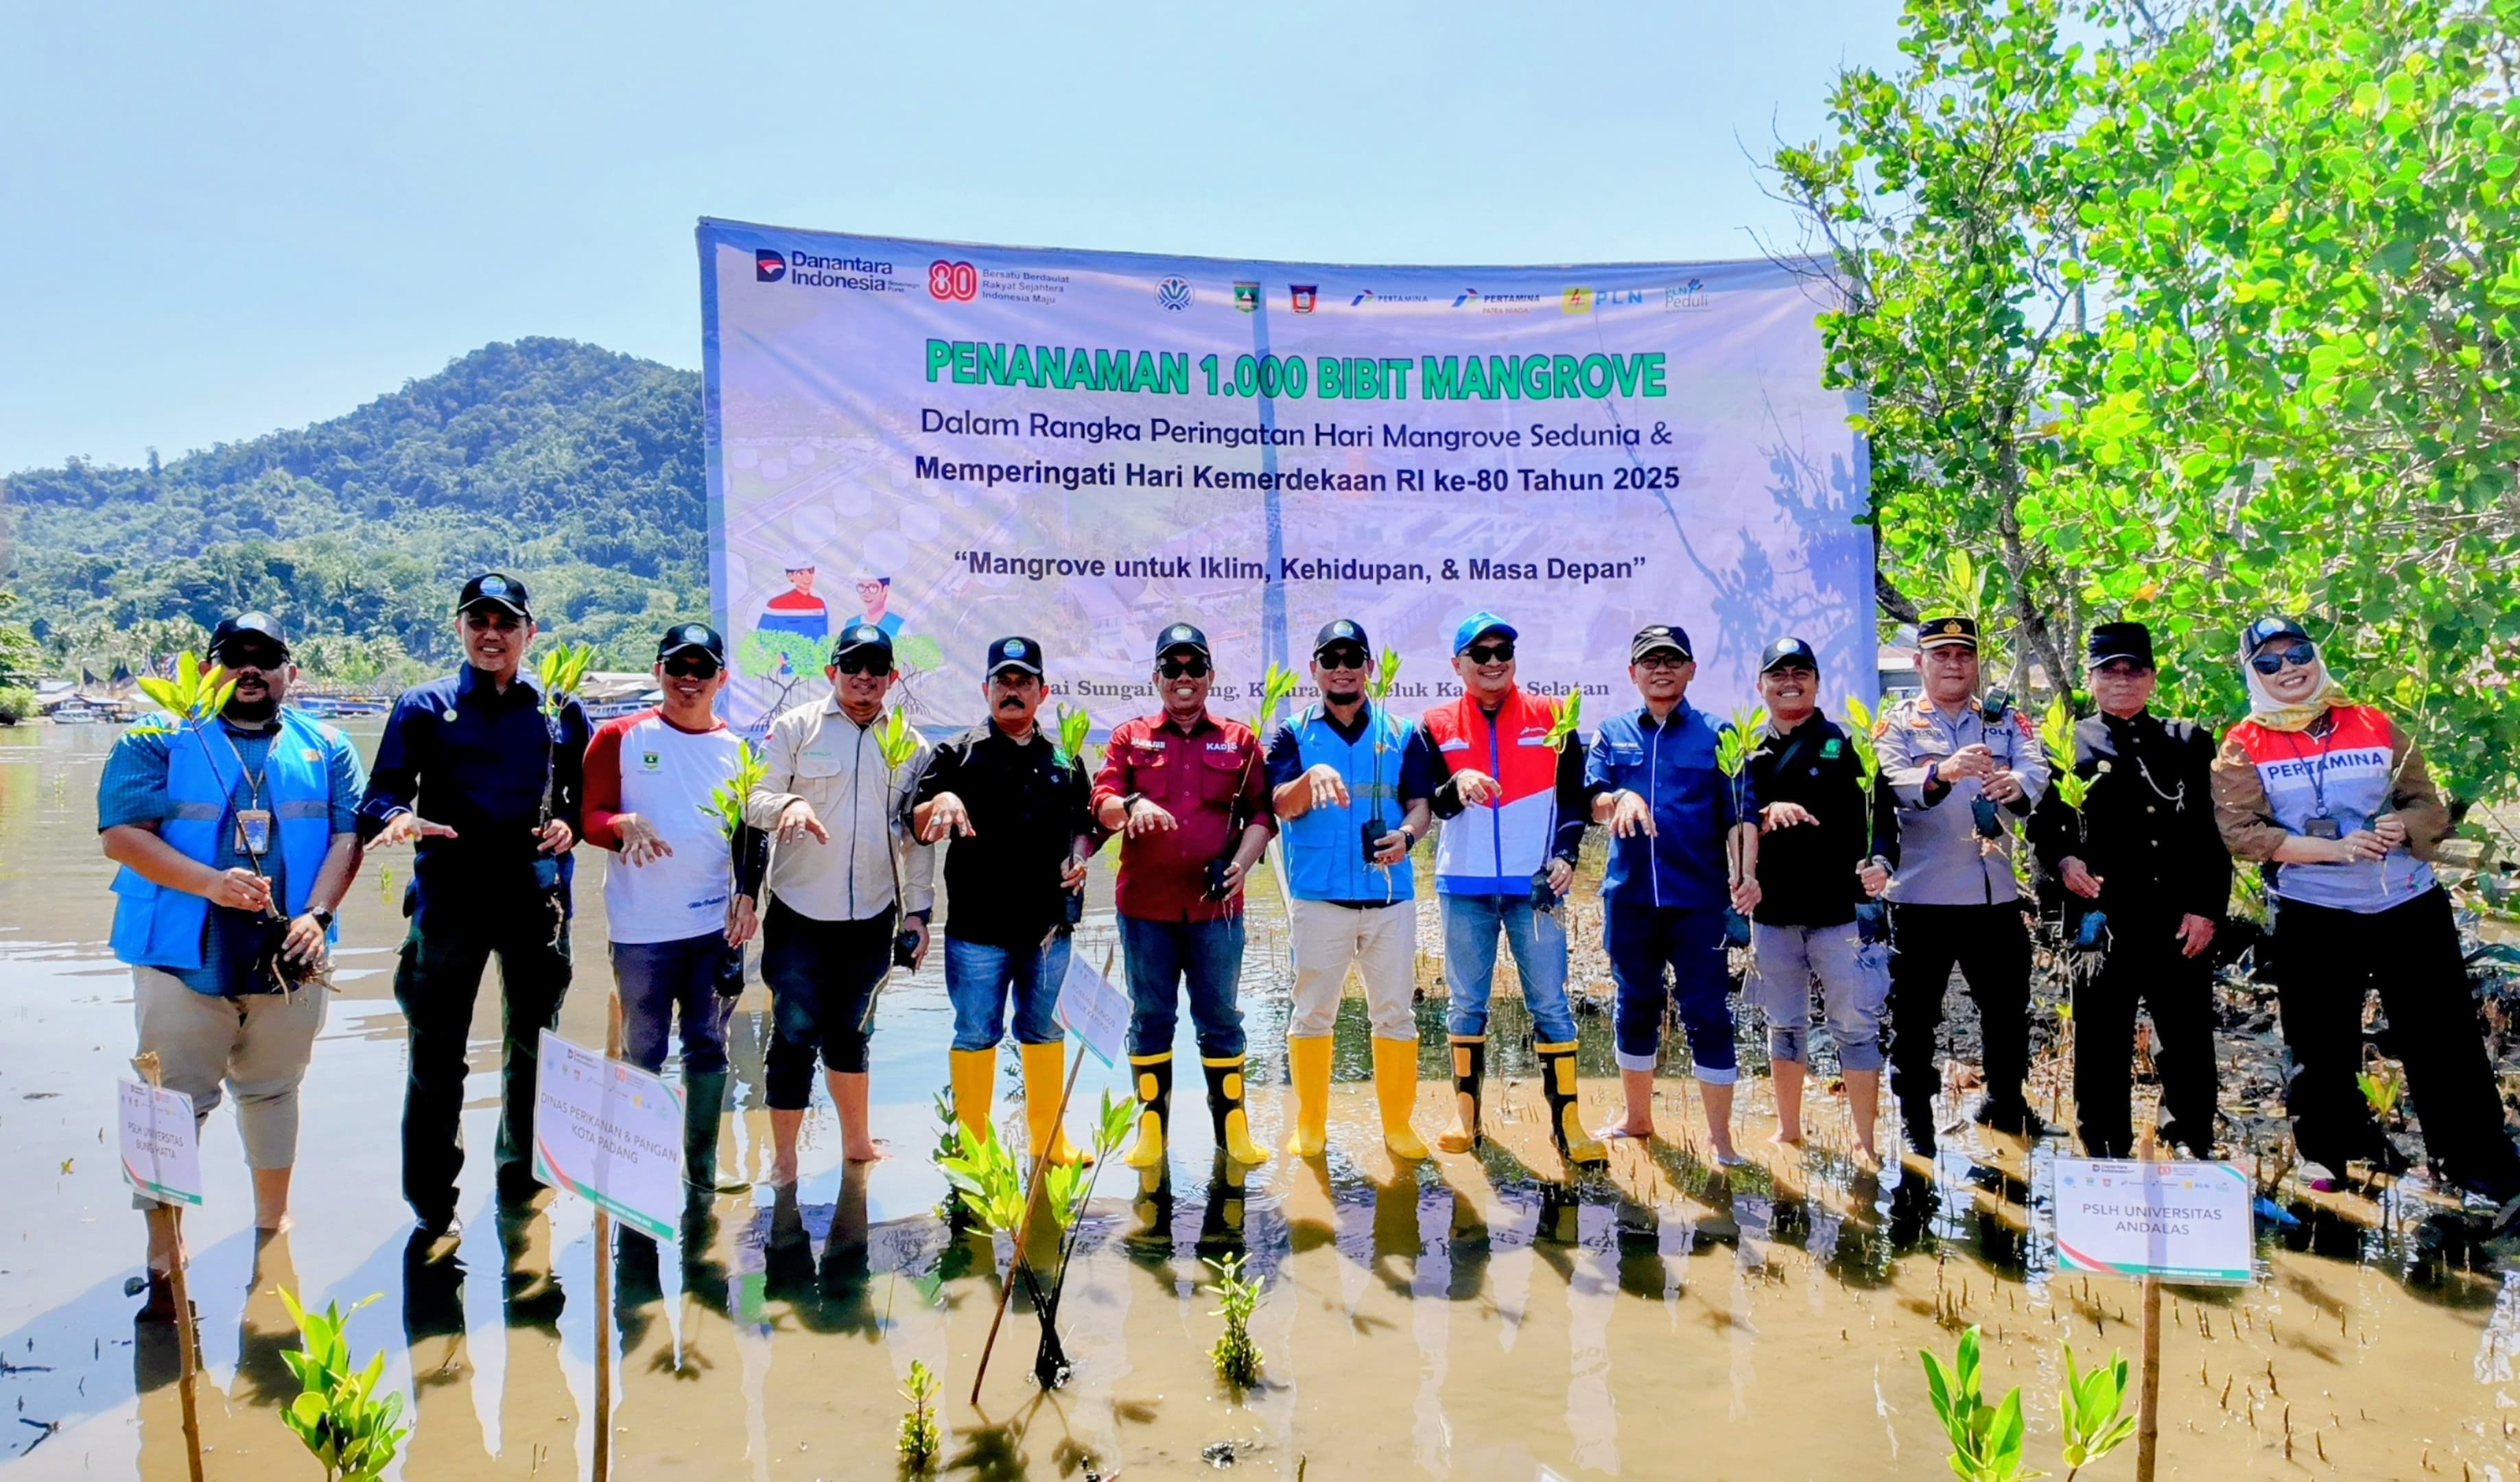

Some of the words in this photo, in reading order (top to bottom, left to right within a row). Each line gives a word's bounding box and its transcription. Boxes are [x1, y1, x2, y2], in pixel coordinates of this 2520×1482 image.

[791, 250, 893, 274] Danantara
[791, 268, 885, 291] Indonesia
[929, 259, 978, 302] 80
[982, 268, 1021, 279] Bersatu
[1023, 272, 1070, 283] Berdaulat
[982, 280, 1016, 292] Rakyat
[1019, 281, 1064, 293] Sejahtera
[982, 290, 1030, 302] Indonesia
[1032, 294, 1056, 305] Maju
[1378, 295, 1428, 303] PERTAMINA
[1483, 294, 1540, 303] PERTAMINA
[1595, 290, 1643, 305] PLN
[1665, 294, 1708, 308] Peduli
[926, 338, 1188, 394] PENANAMAN
[1199, 353, 1306, 399] 1.000
[1317, 356, 1413, 399] BIBIT
[1422, 352, 1667, 400] MANGROVE
[921, 409, 1020, 437] Dalam
[1030, 413, 1141, 445] Rangka
[1151, 419, 1305, 450] Peringatan
[1315, 423, 1374, 447] Hari
[1383, 423, 1520, 451] Mangrove
[1531, 421, 1640, 447] Sedunia
[1650, 421, 1673, 445] &
[915, 456, 1116, 489] Memperingati
[1126, 462, 1182, 488] Hari
[1193, 465, 1387, 492] Kemerdekaan
[1396, 468, 1424, 491] RI
[1435, 468, 1509, 492] ke-80
[1518, 467, 1605, 491] Tahun
[1613, 466, 1680, 490] 2025
[954, 551, 1105, 580] “Mangrove
[1114, 554, 1192, 578] untuk
[1200, 556, 1271, 583] Iklim,
[1280, 557, 1433, 585] Kehidupan,
[1441, 558, 1459, 581] &
[1468, 558, 1538, 580] Masa
[1547, 556, 1647, 585] Depan”
[1078, 680, 1154, 700] Sungai
[1527, 681, 1609, 696] Selatan
[2267, 751, 2384, 779] PERTAMINA
[540, 1092, 568, 1114] DINAS
[569, 1105, 622, 1138] PERIKANAN
[624, 1131, 632, 1143] &
[634, 1135, 677, 1164] PANGAN
[571, 1125, 596, 1143] KOTA
[598, 1138, 638, 1164] PADANG
[2082, 1203, 2119, 1216] PSLH
[2124, 1204, 2222, 1220] UNIVERSITAS
[2115, 1221, 2189, 1235] ANDALAS
